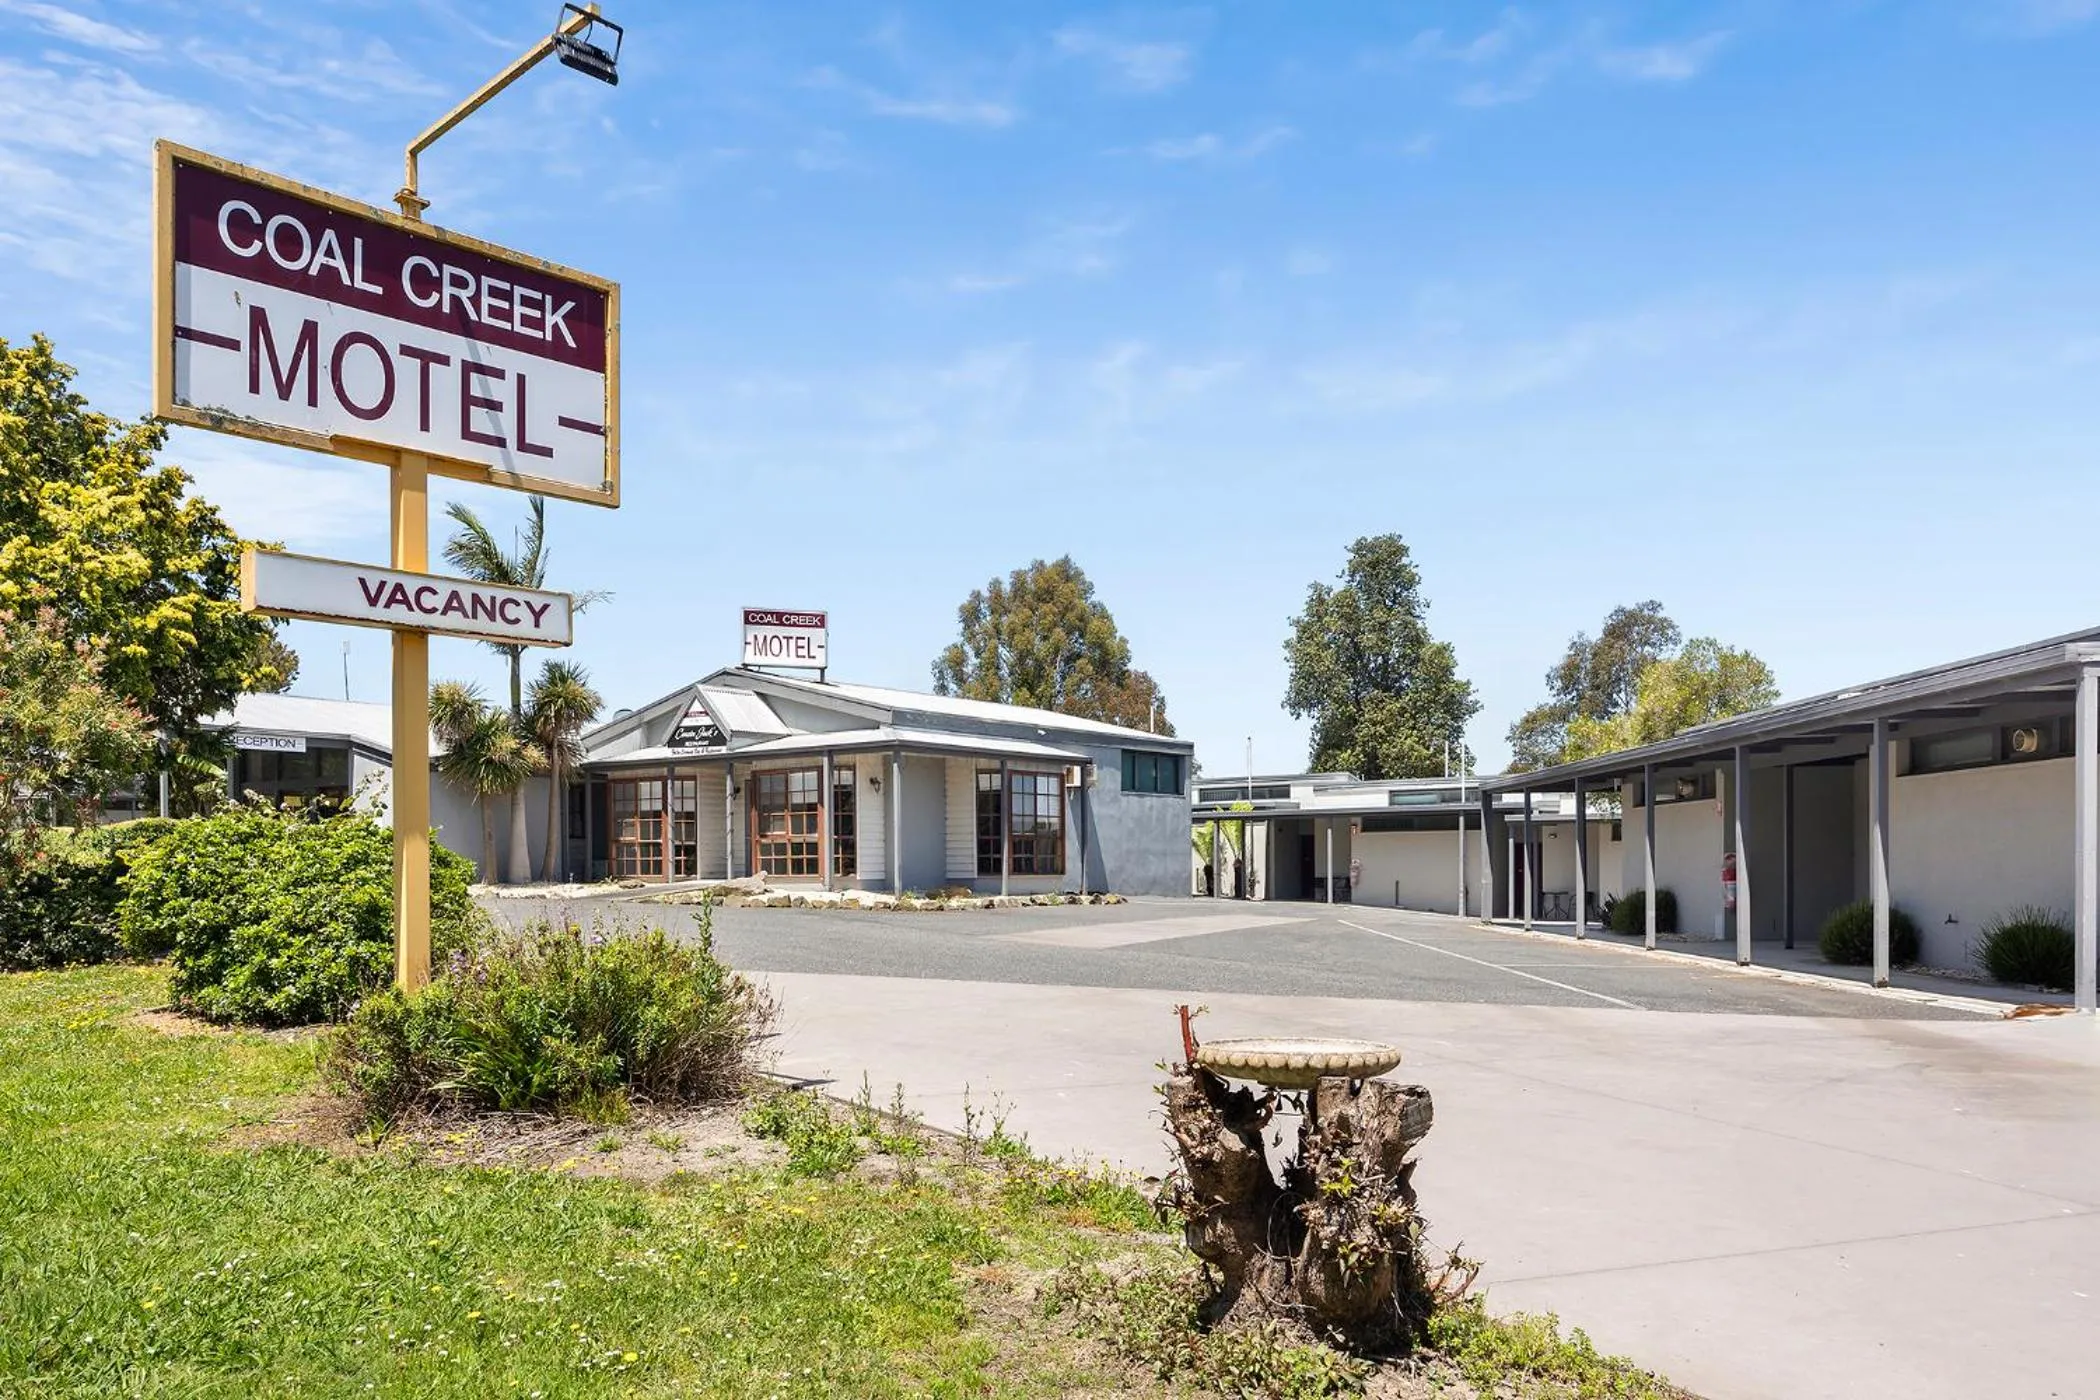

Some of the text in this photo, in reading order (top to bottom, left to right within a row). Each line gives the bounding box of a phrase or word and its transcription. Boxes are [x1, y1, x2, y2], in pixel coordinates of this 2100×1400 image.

[217, 199, 577, 348] COAL CREEK
[248, 304, 554, 459] MOTEL
[357, 577, 552, 629] VACANCY
[748, 612, 821, 625] COAL CREEK
[753, 634, 816, 659] MOTEL
